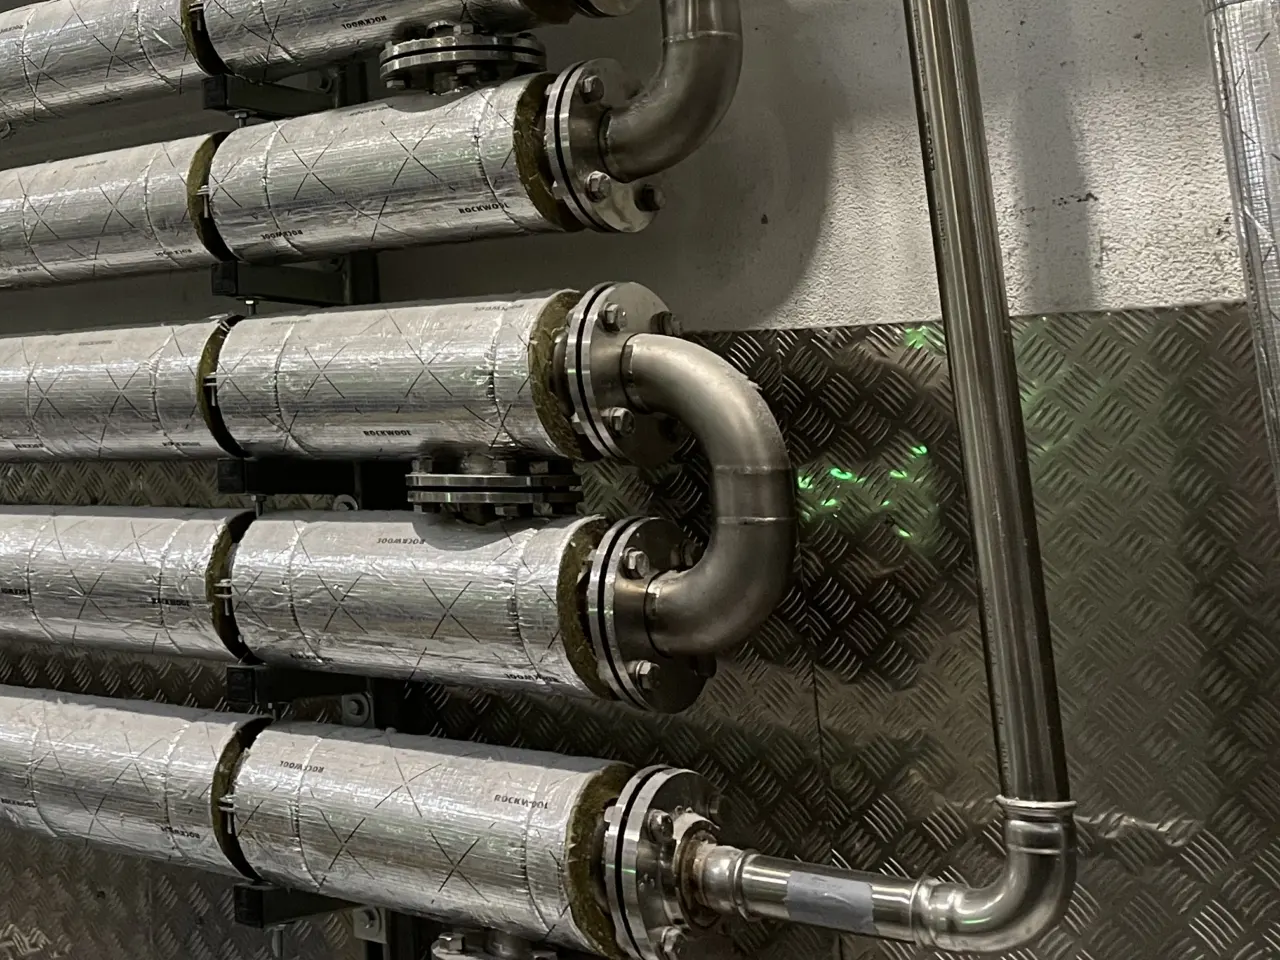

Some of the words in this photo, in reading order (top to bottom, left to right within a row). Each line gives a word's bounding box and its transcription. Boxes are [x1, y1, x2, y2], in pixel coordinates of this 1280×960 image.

[342, 15, 387, 30] ROCKWOOL
[458, 202, 510, 215] ROCKWOOL
[363, 429, 412, 437] ROCKWOOL
[377, 537, 425, 546] ROCKWOOL
[494, 794, 549, 809] ROCKWOOL
